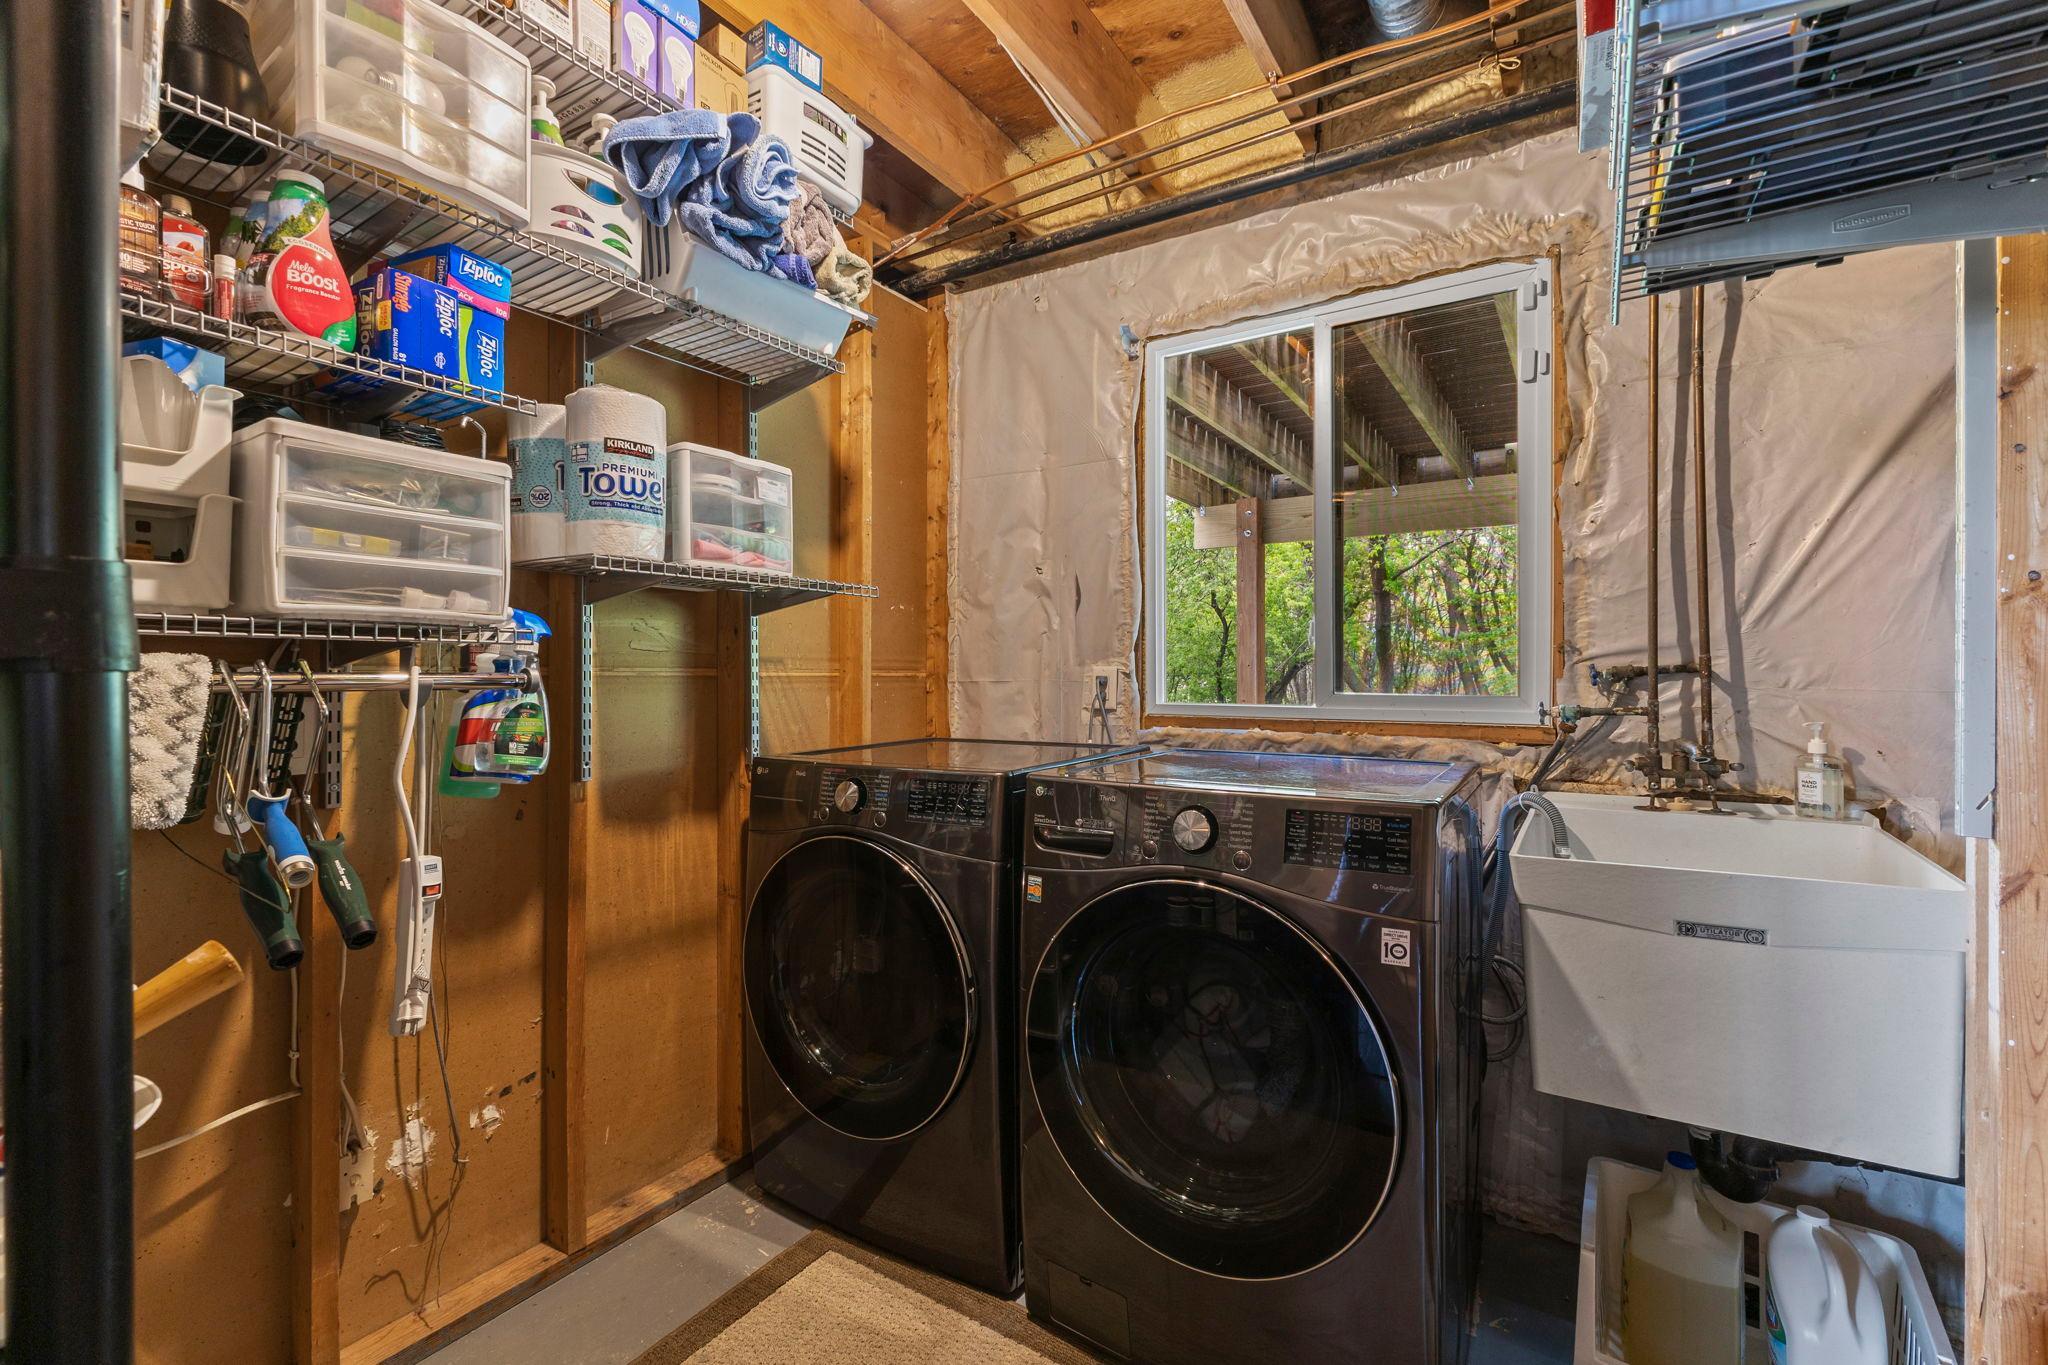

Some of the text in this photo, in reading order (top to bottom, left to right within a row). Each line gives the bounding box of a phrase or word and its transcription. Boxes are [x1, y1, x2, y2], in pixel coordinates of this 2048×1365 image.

[119, 217, 135, 227] STIC
[1836, 209, 1906, 230] Rubbermaid
[463, 256, 504, 288] Ziploc
[285, 283, 320, 296] Fragrance
[394, 272, 412, 313] Storage
[458, 291, 474, 303] ACK
[358, 291, 373, 357] Ziploc
[435, 295, 454, 337] Ziploc
[476, 335, 496, 378] Ziploc
[606, 438, 654, 455] KIRKLAND
[603, 463, 657, 479] PREMIUM
[530, 493, 550, 502] 20%
[591, 499, 613, 508] Strong,
[1384, 942, 1408, 960] 10
